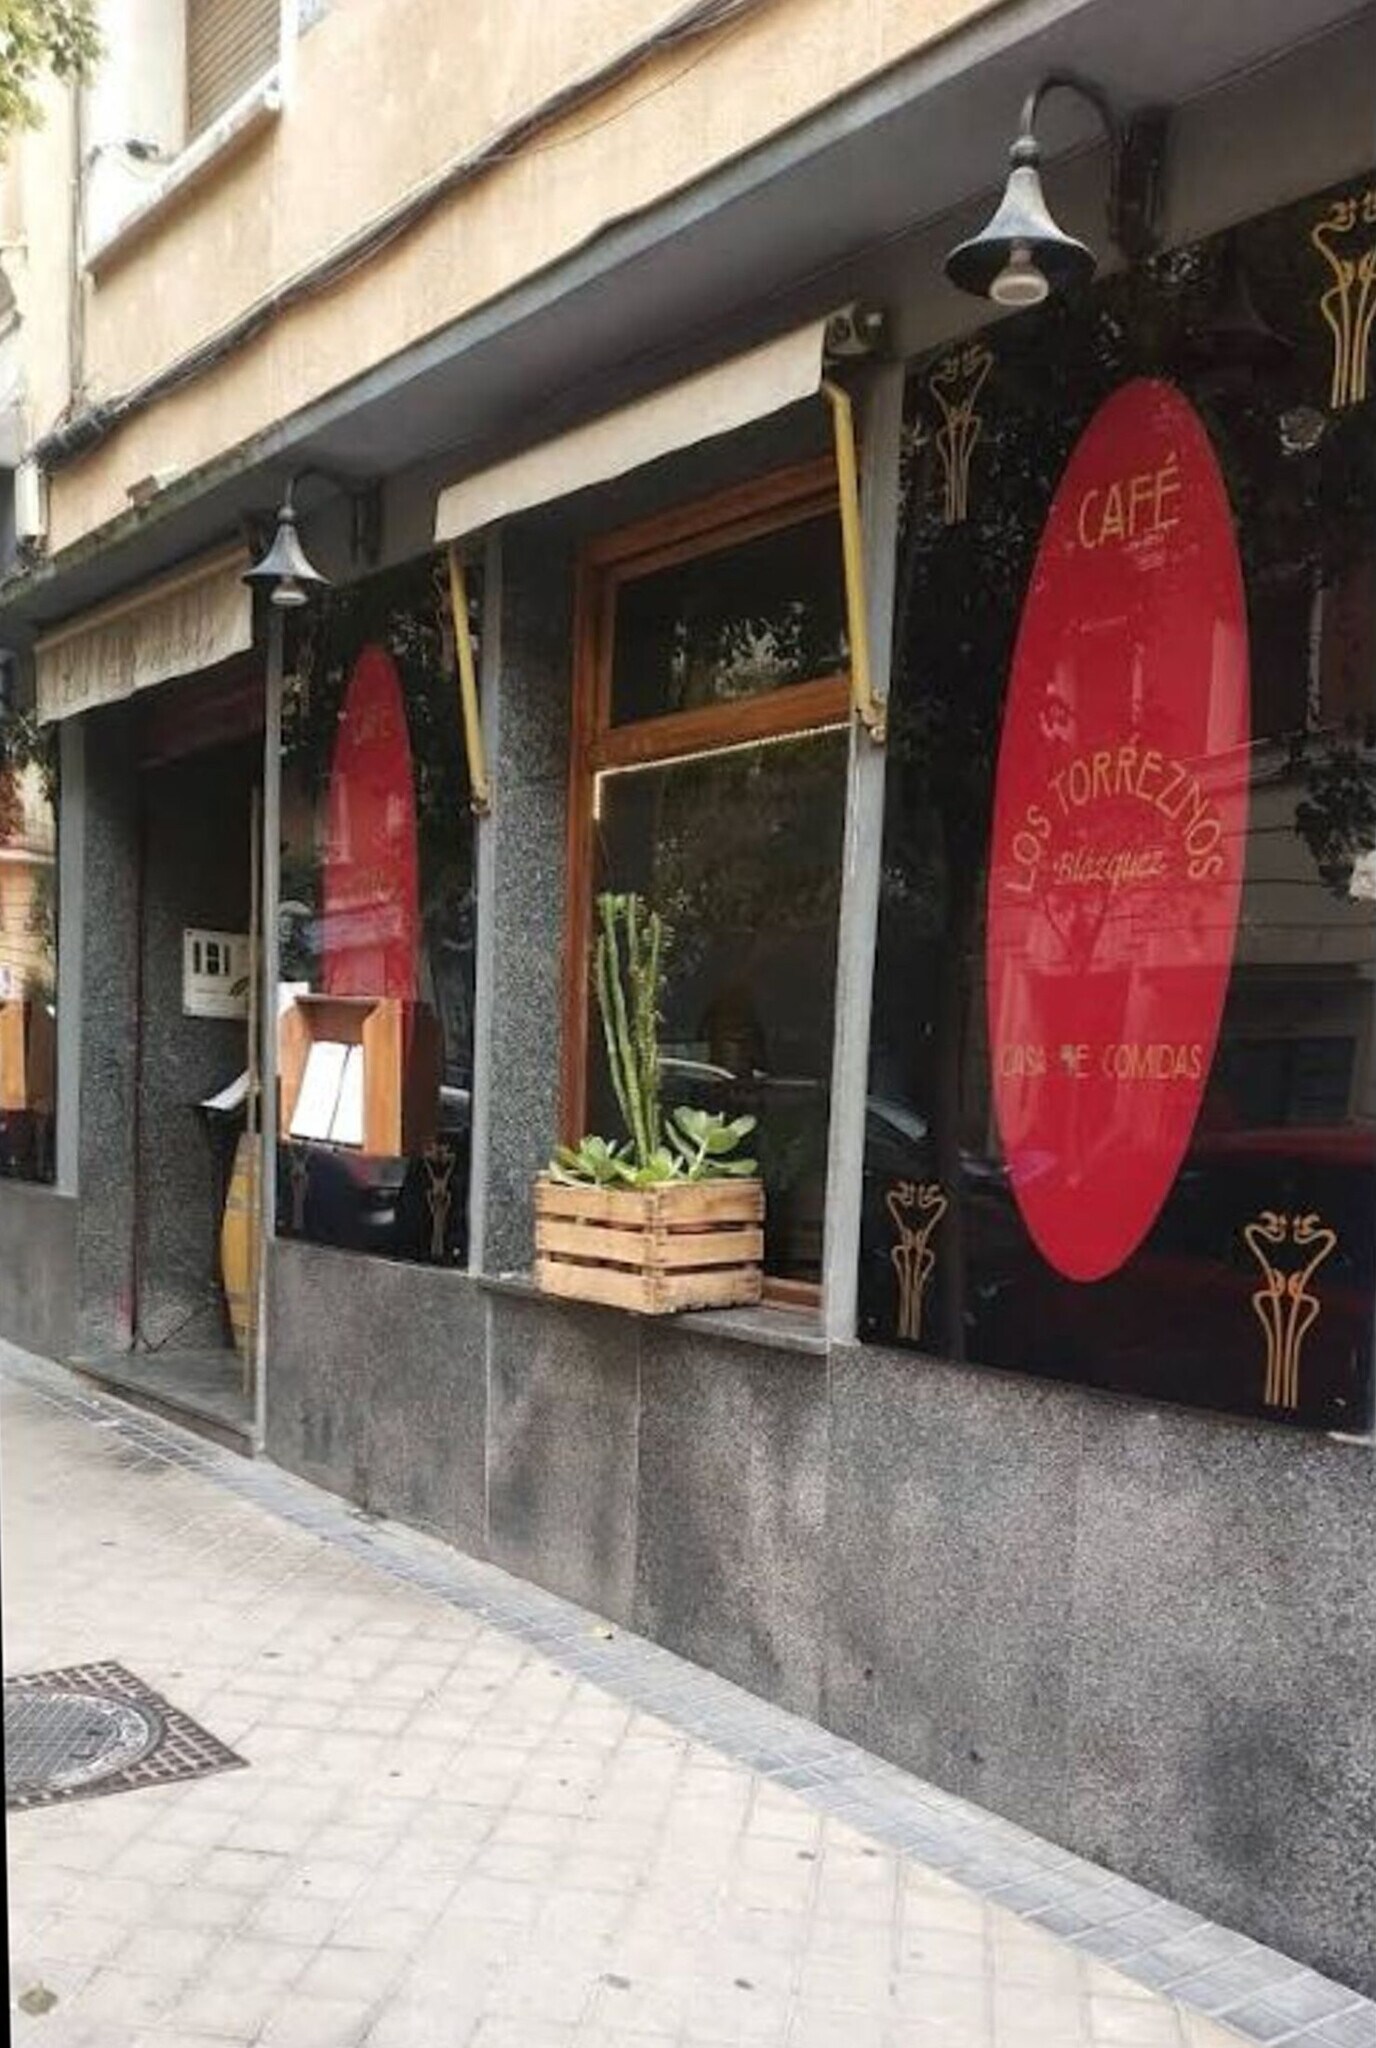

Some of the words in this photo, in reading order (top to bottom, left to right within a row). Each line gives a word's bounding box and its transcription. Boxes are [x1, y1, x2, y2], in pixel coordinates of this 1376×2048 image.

[1078, 451, 1182, 549] CAFÉ
[1004, 804, 1050, 893] LOS
[1102, 1043, 1203, 1080] COMIDAS
